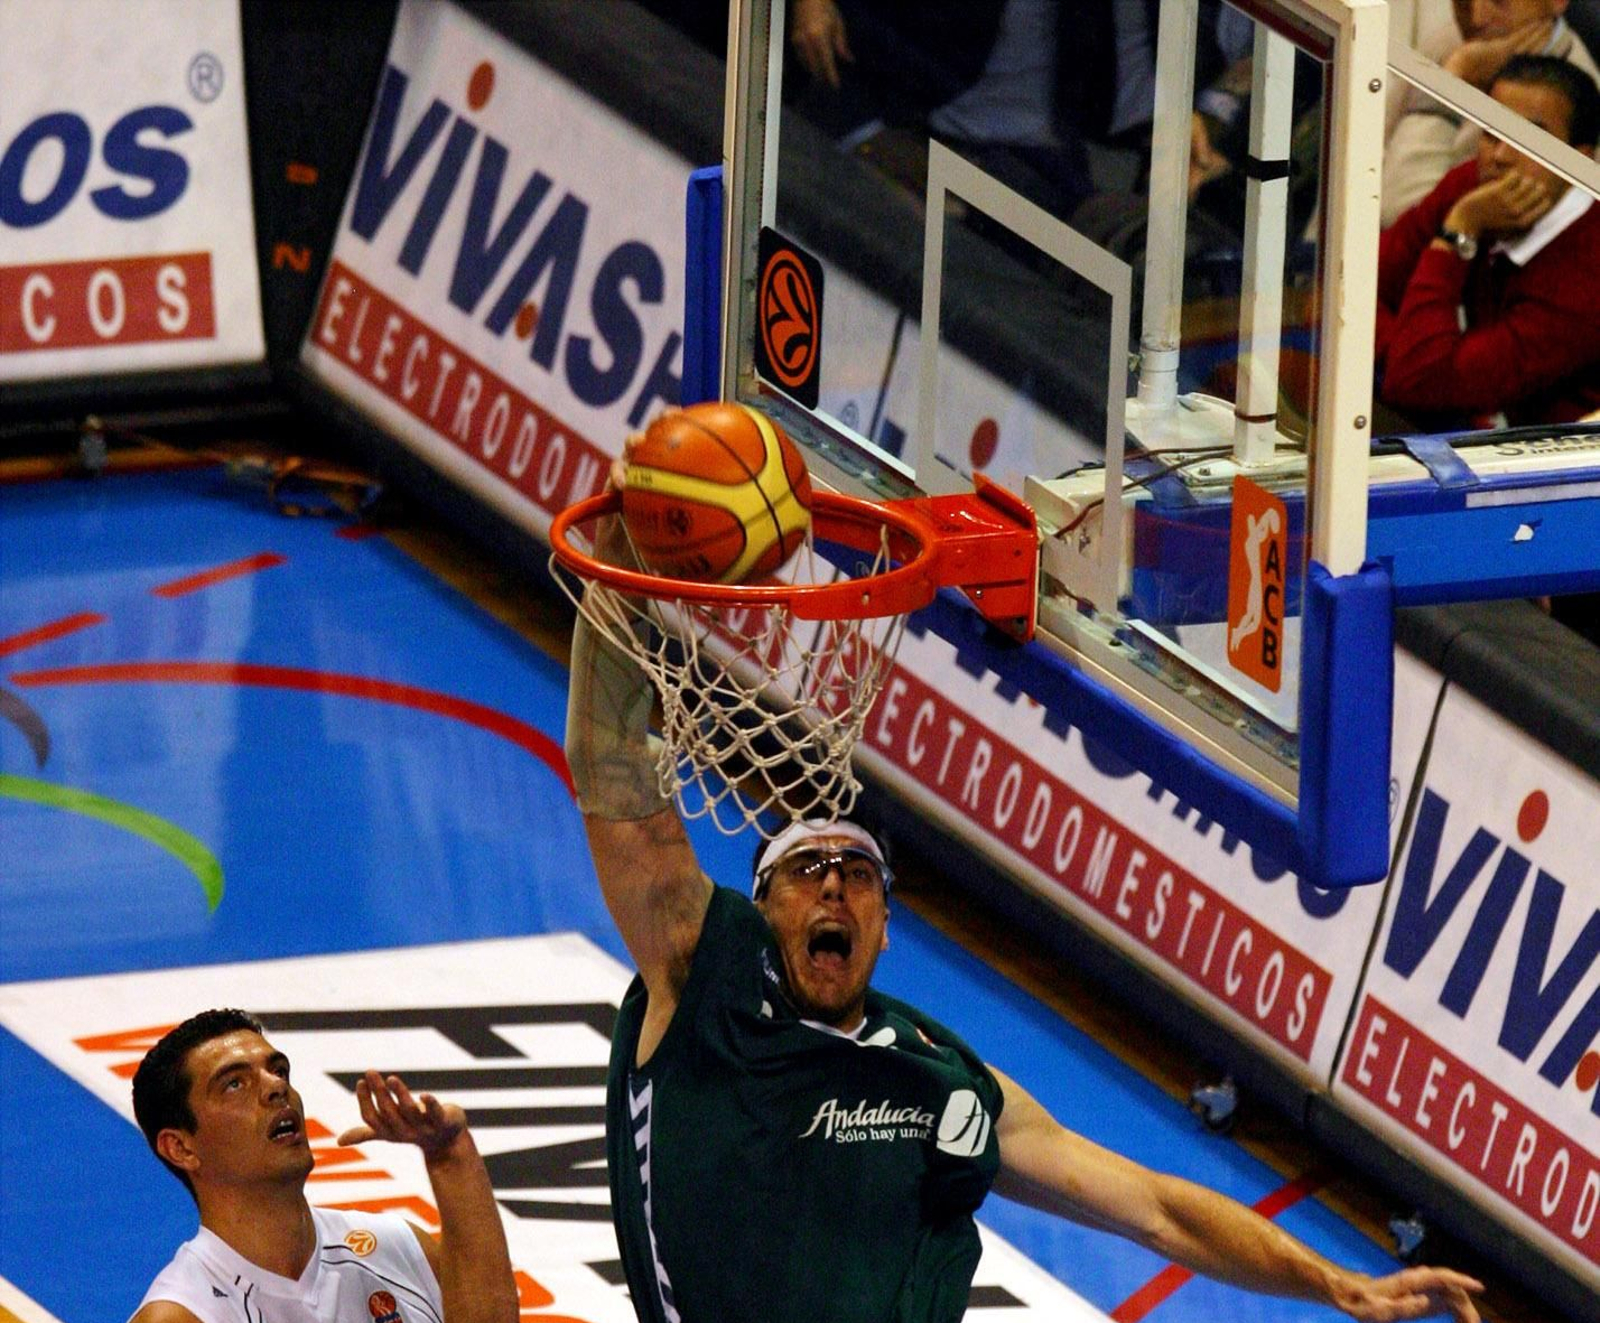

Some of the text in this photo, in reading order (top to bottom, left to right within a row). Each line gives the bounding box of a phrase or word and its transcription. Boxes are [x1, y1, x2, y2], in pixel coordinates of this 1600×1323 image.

[21, 263, 190, 342] COS
[1262, 538, 1281, 670] ACB
[835, 1128, 867, 1144] Sólo
[870, 1127, 896, 1143] hay
